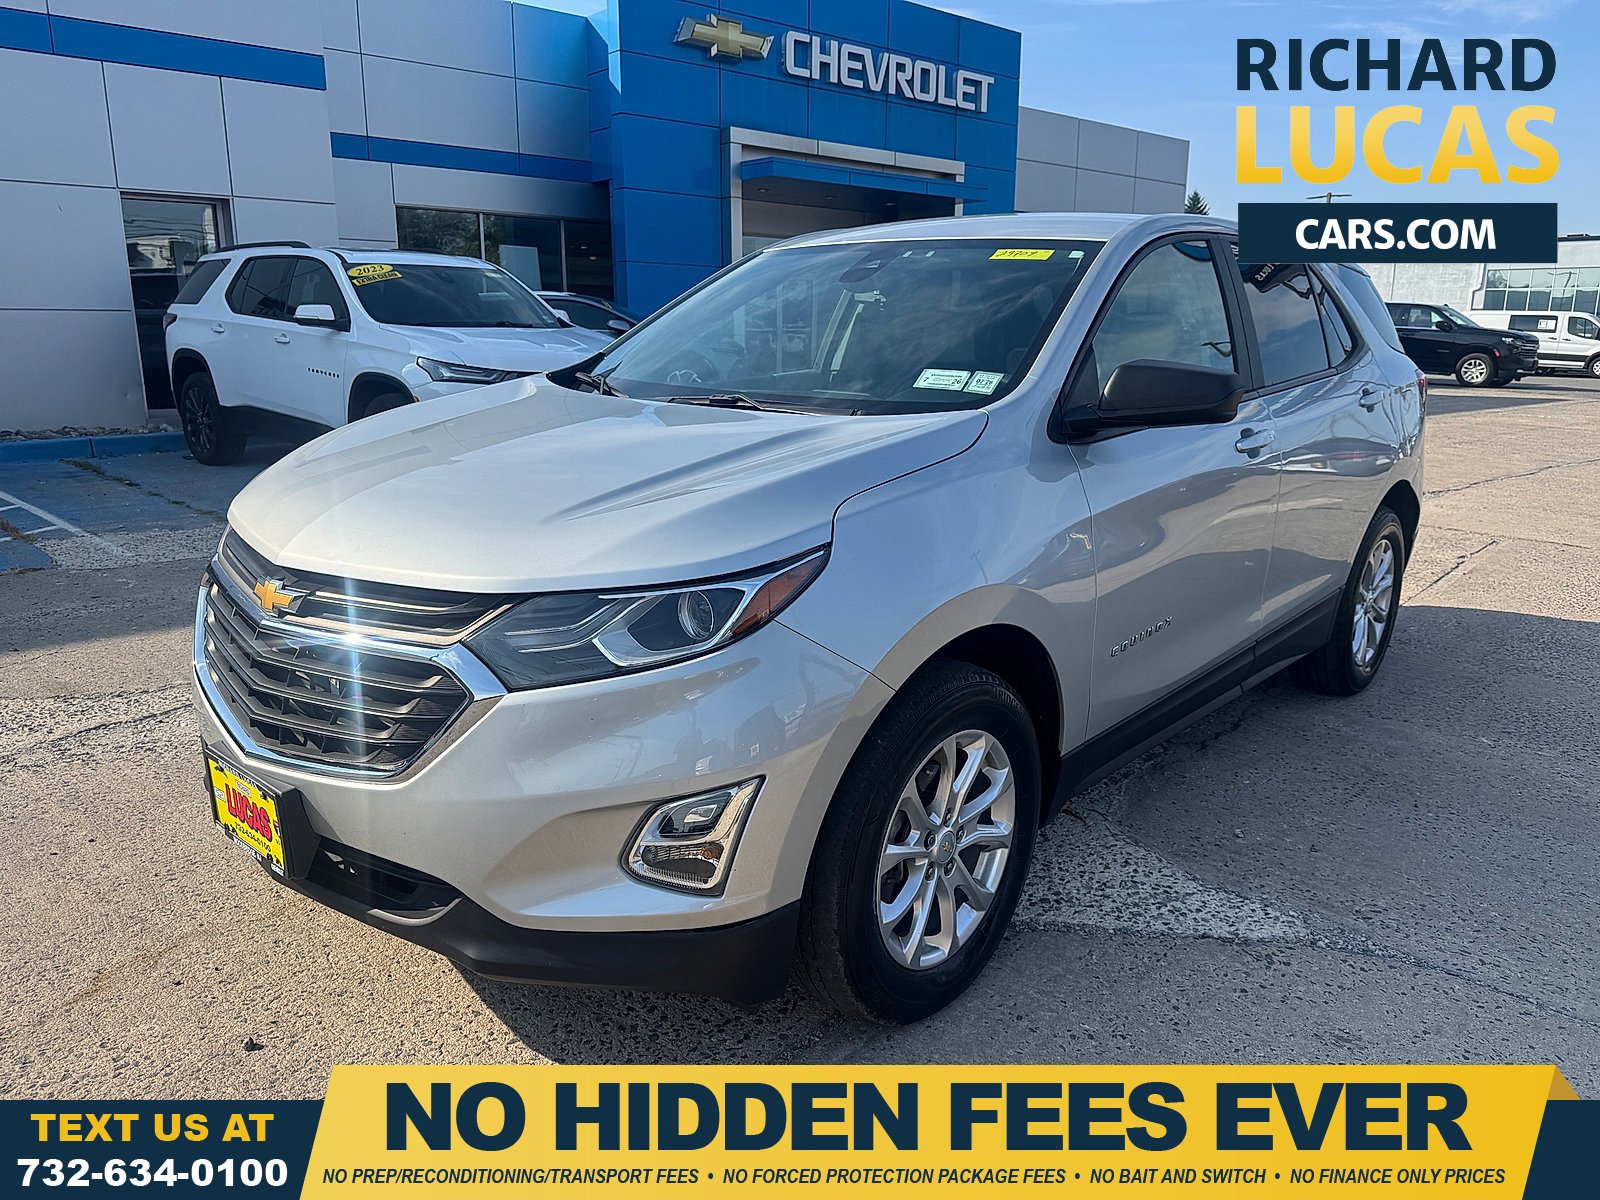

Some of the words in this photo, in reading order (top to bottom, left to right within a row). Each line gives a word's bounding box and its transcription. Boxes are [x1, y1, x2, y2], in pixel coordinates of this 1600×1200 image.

[782, 30, 995, 113] CHEVROLET
[355, 264, 385, 276] 2023
[1110, 616, 1173, 657] EQUINOX
[224, 782, 273, 842] LUCAS
